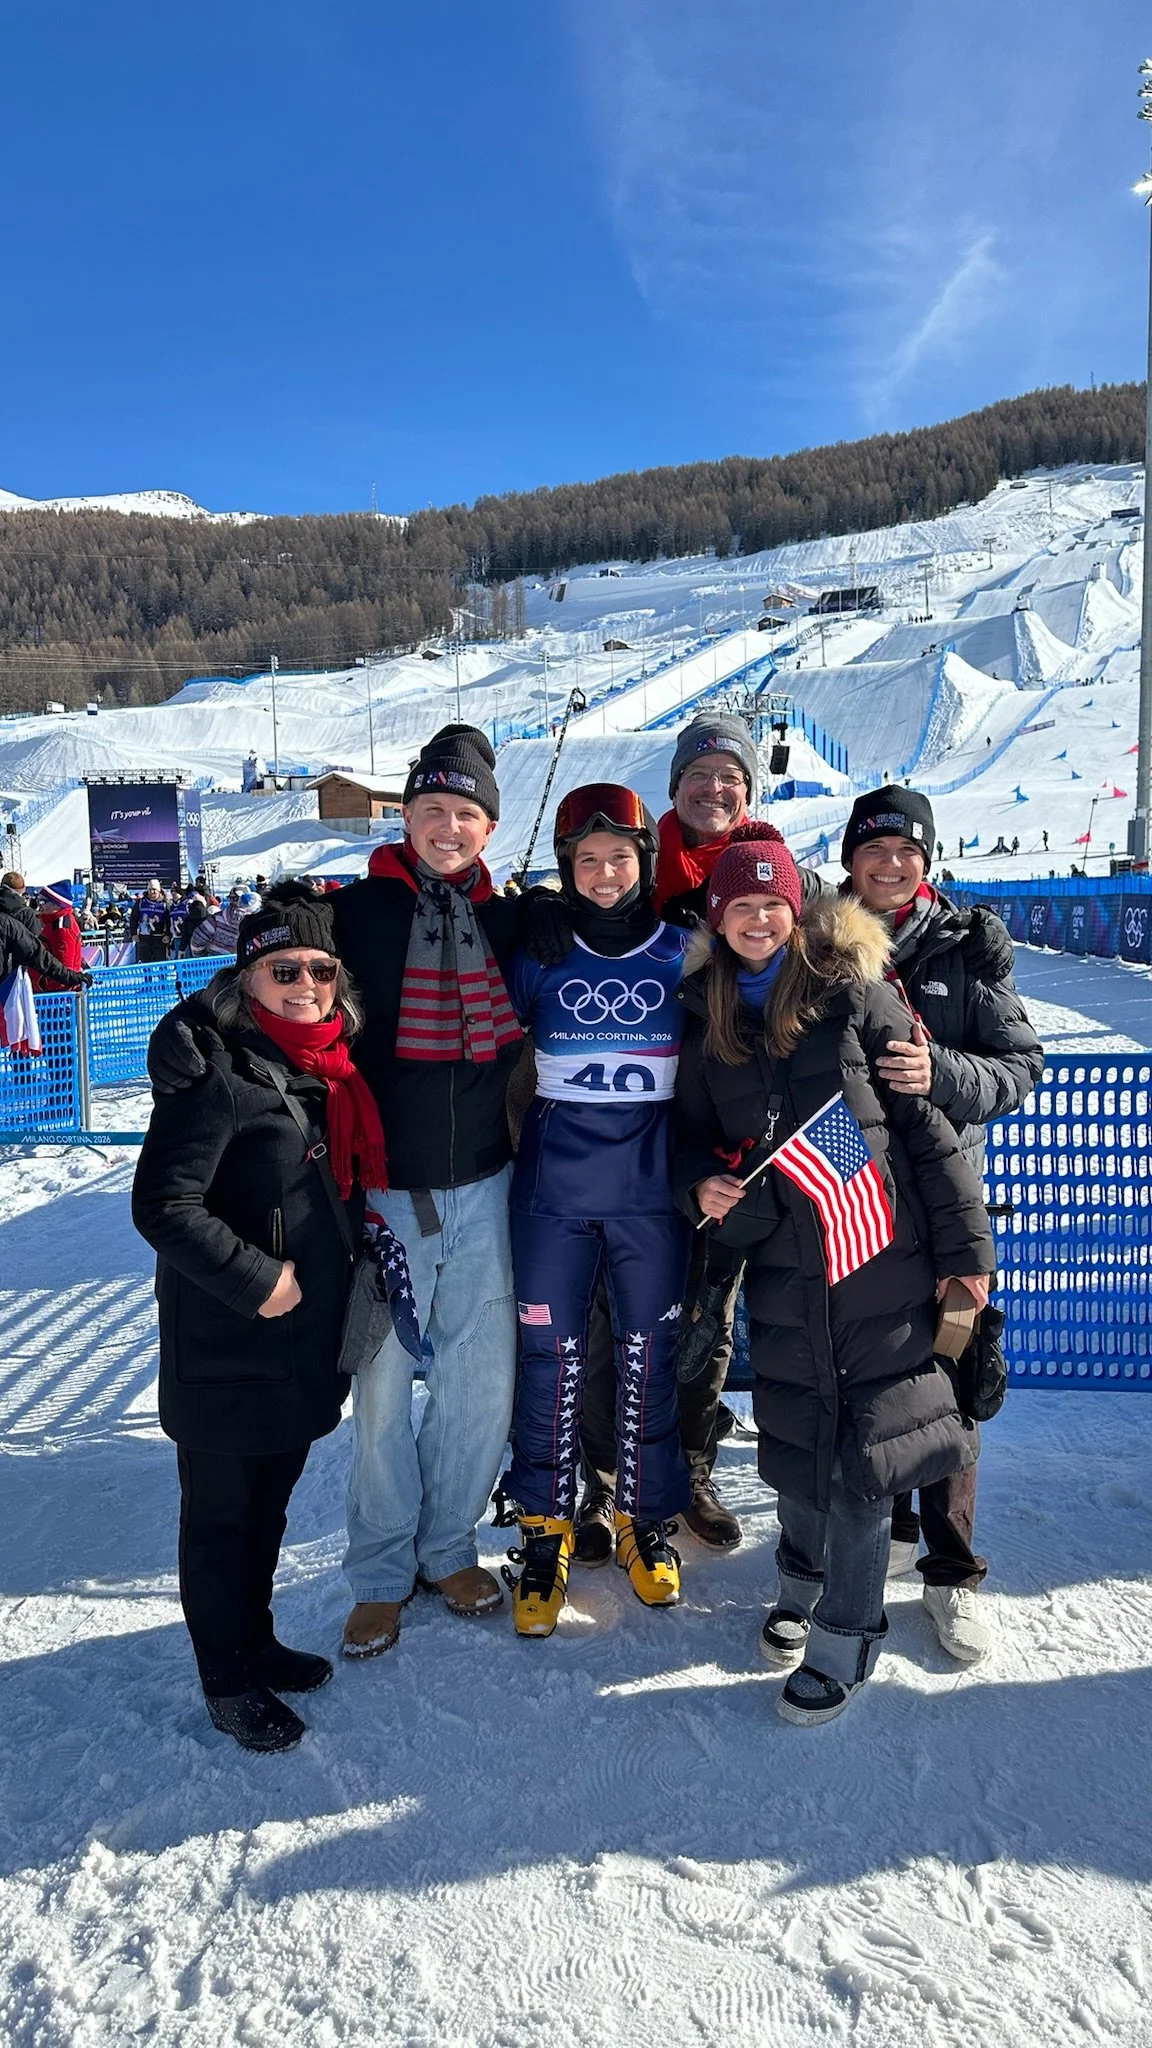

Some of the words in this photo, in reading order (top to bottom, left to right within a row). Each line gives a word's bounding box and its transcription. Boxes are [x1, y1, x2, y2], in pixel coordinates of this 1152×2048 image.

[549, 1031, 595, 1041] MILANO
[596, 1032, 648, 1041] CORTINA
[650, 1033, 672, 1041] 2026
[563, 1063, 656, 1092] 40
[21, 1135, 55, 1143] MILANO
[56, 1135, 93, 1143] CORTINA
[93, 1135, 111, 1143] 2026
